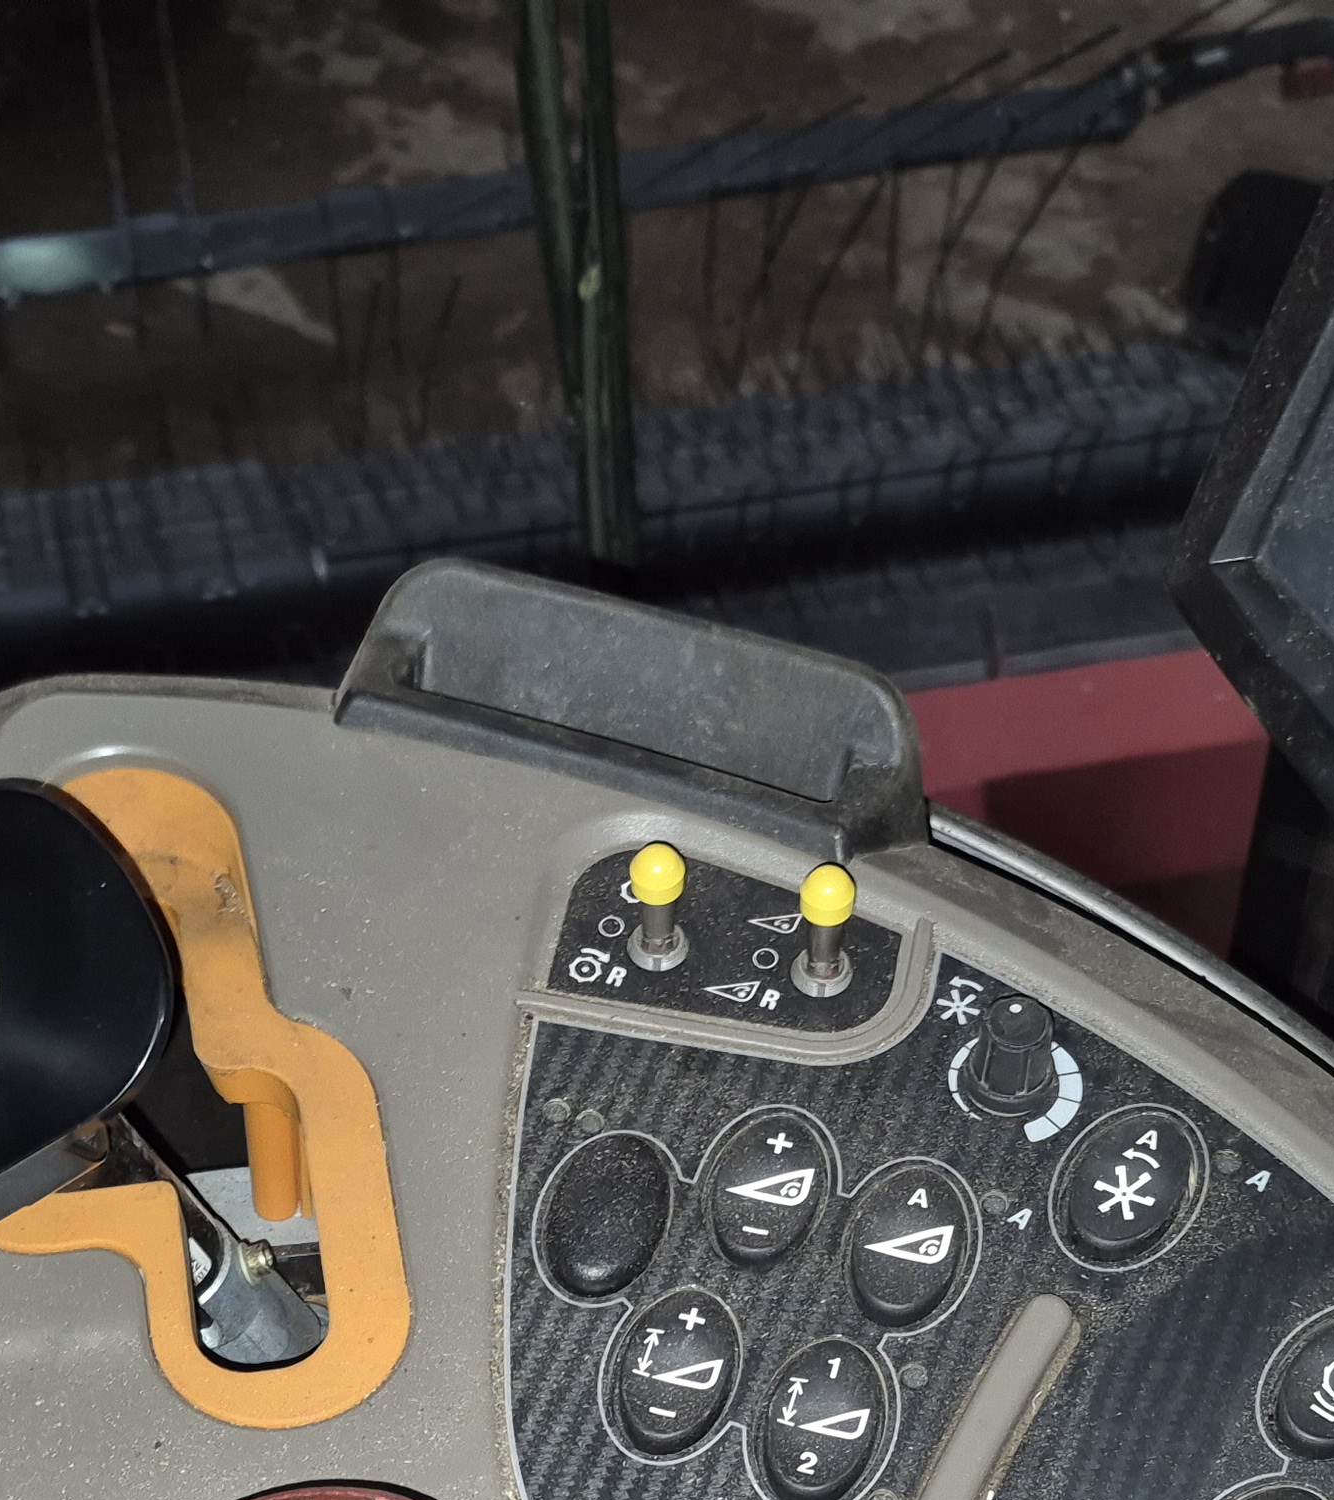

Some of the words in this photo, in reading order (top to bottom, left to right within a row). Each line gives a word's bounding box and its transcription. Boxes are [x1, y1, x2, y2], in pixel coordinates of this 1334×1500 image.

[605, 966, 627, 987] R
[759, 989, 781, 1010] R
[1135, 1130, 1158, 1150] A
[1245, 1171, 1271, 1192] A
[907, 1188, 930, 1208] A
[1006, 1208, 1033, 1230] A
[827, 1357, 841, 1379] 1
[796, 1451, 818, 1475] 2
